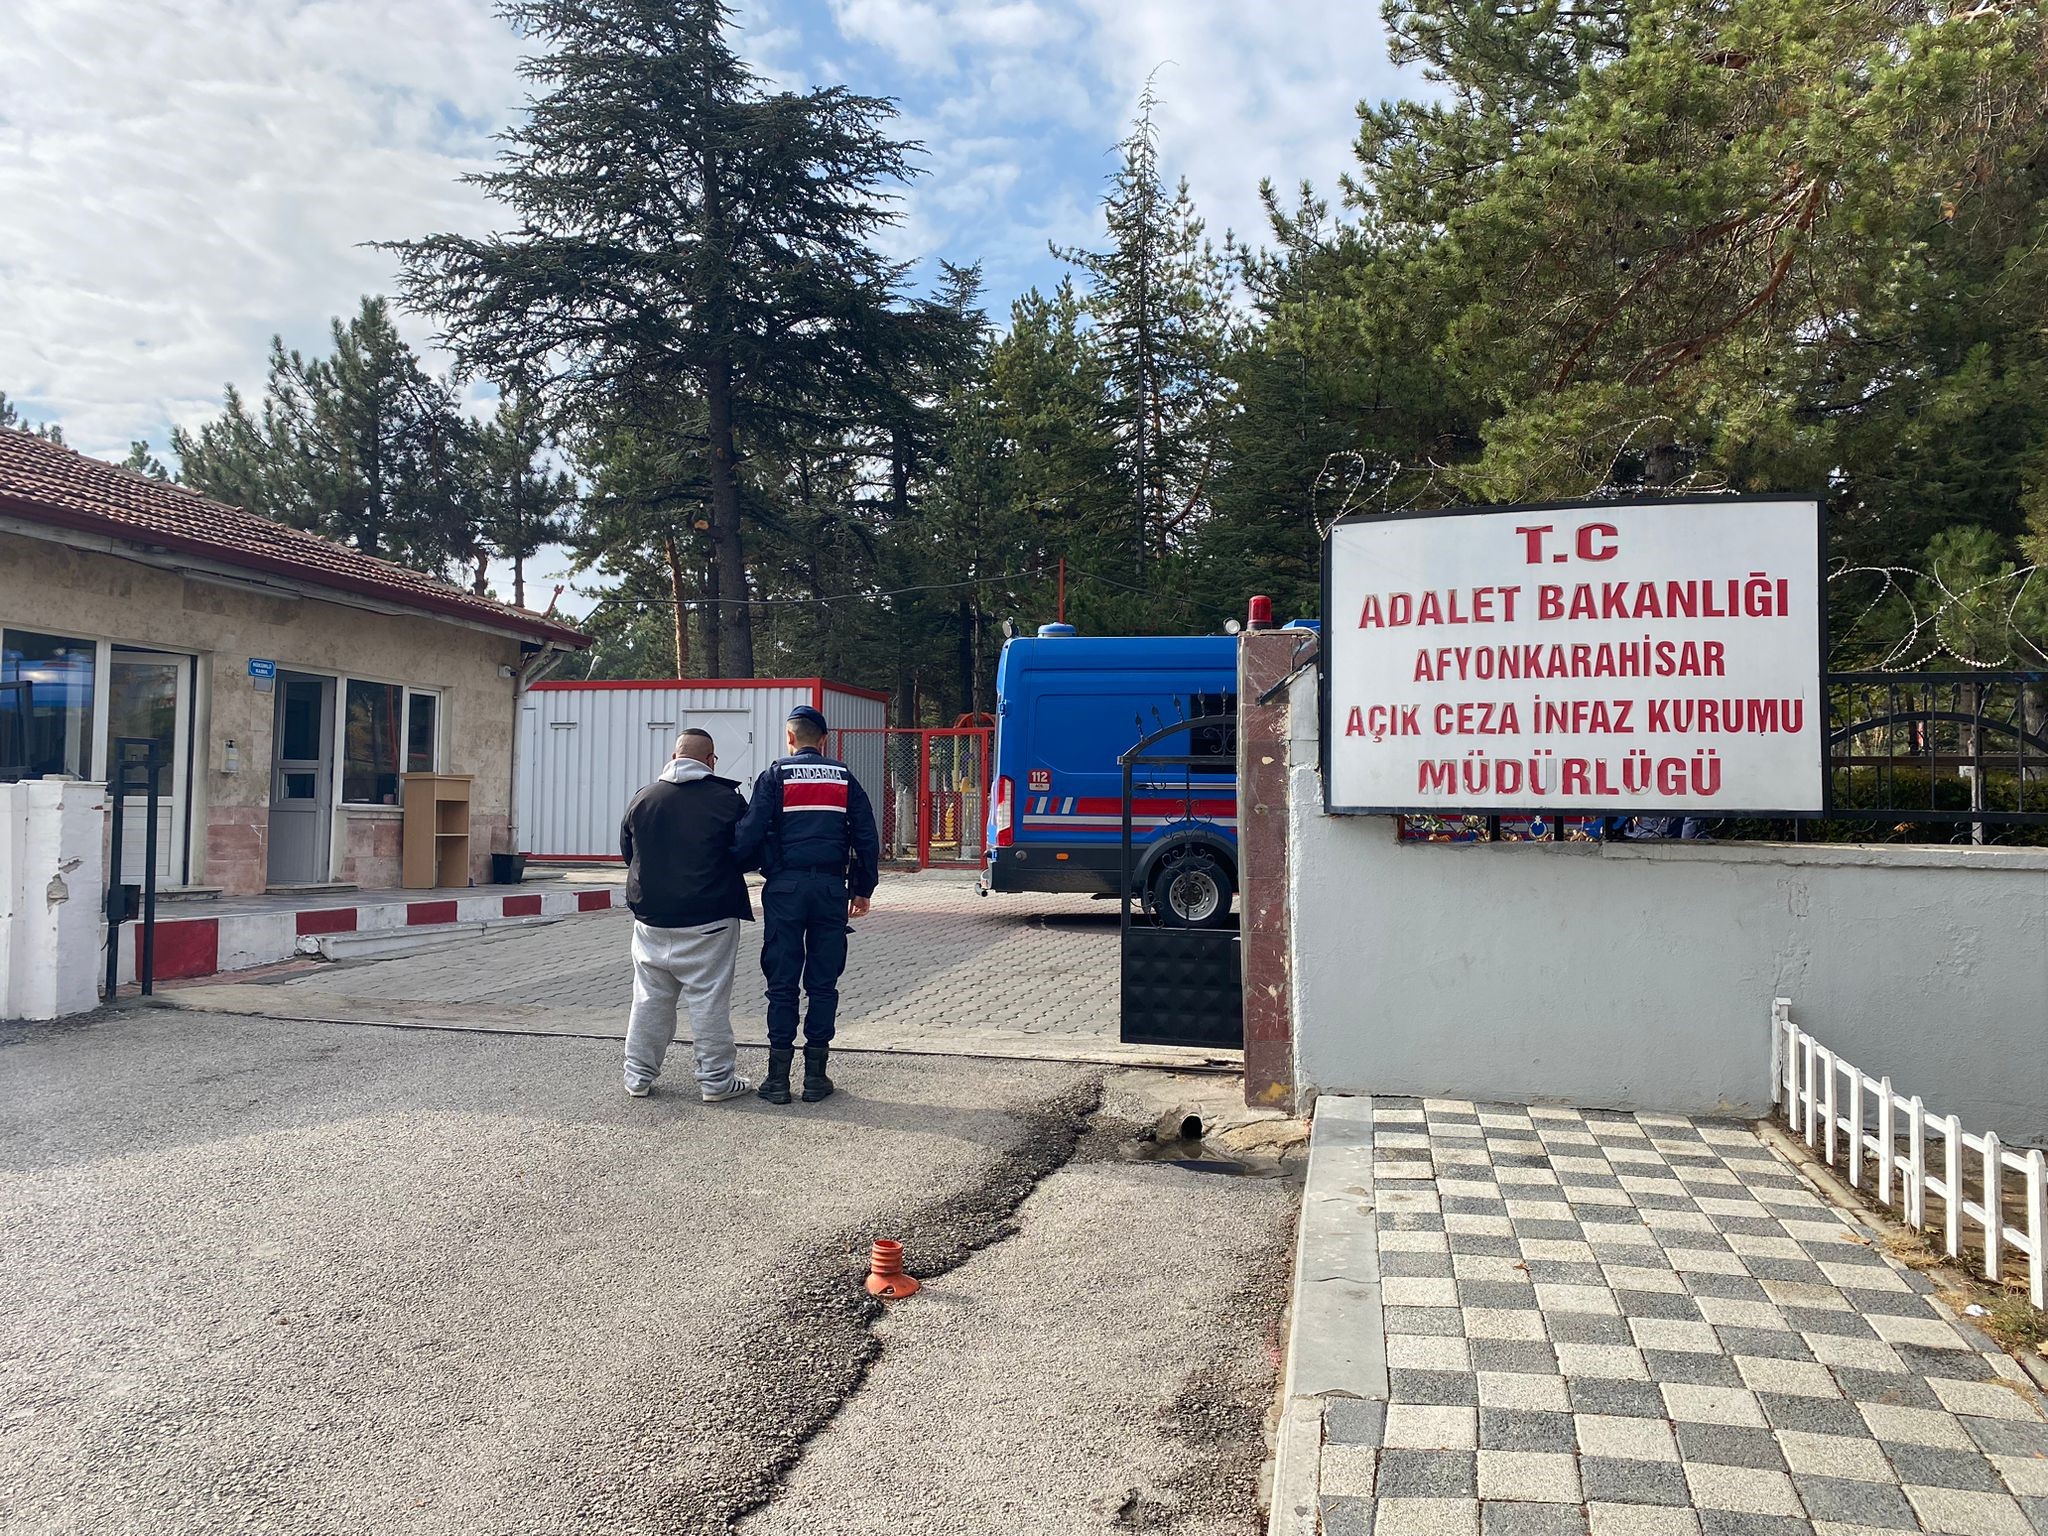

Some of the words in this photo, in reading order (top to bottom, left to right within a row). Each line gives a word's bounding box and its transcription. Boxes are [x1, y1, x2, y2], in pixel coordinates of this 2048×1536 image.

[1515, 522, 1619, 565] T.C
[1358, 585, 1522, 630] ADALET
[1537, 571, 1789, 621] BAKANLIĞI
[1413, 633, 1726, 683] AFYONKARAHİSAR
[1345, 703, 1421, 744] AÇIK
[1433, 701, 1520, 735] CEZA
[1533, 693, 1634, 735] İNFAZ
[1648, 698, 1804, 735] KURUMU
[790, 768, 842, 780] JANDARMA
[1031, 771, 1048, 782] 112
